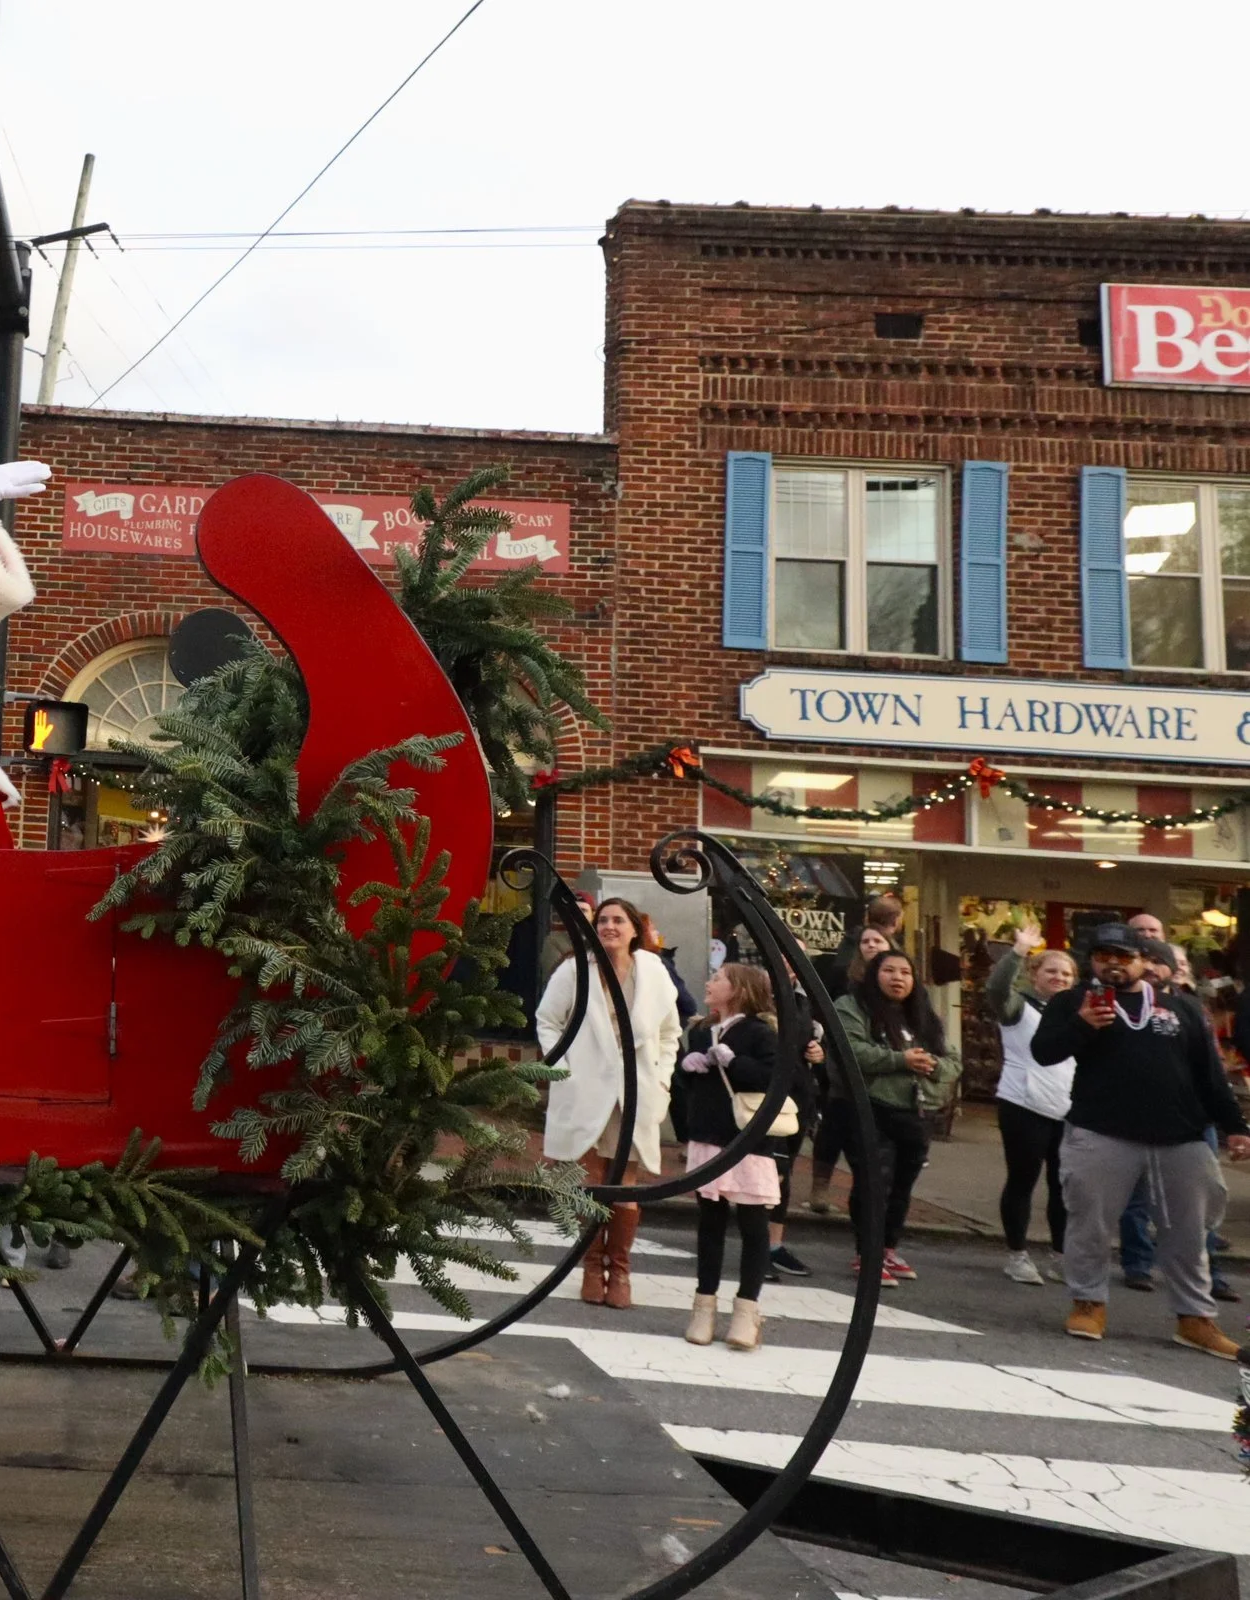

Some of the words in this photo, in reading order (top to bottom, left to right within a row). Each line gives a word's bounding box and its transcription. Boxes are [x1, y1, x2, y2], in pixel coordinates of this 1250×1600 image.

[1126, 305, 1250, 376] Be
[93, 496, 127, 512] GIFTS
[139, 493, 205, 515] GARD
[124, 519, 183, 533] PLUMBING
[382, 507, 434, 531] BOO
[69, 521, 183, 549] HOUSEWARES
[506, 542, 538, 556] TOYS
[790, 688, 923, 727] TOWN
[957, 696, 1198, 742] HARDWARE
[773, 907, 846, 931] TOWN
